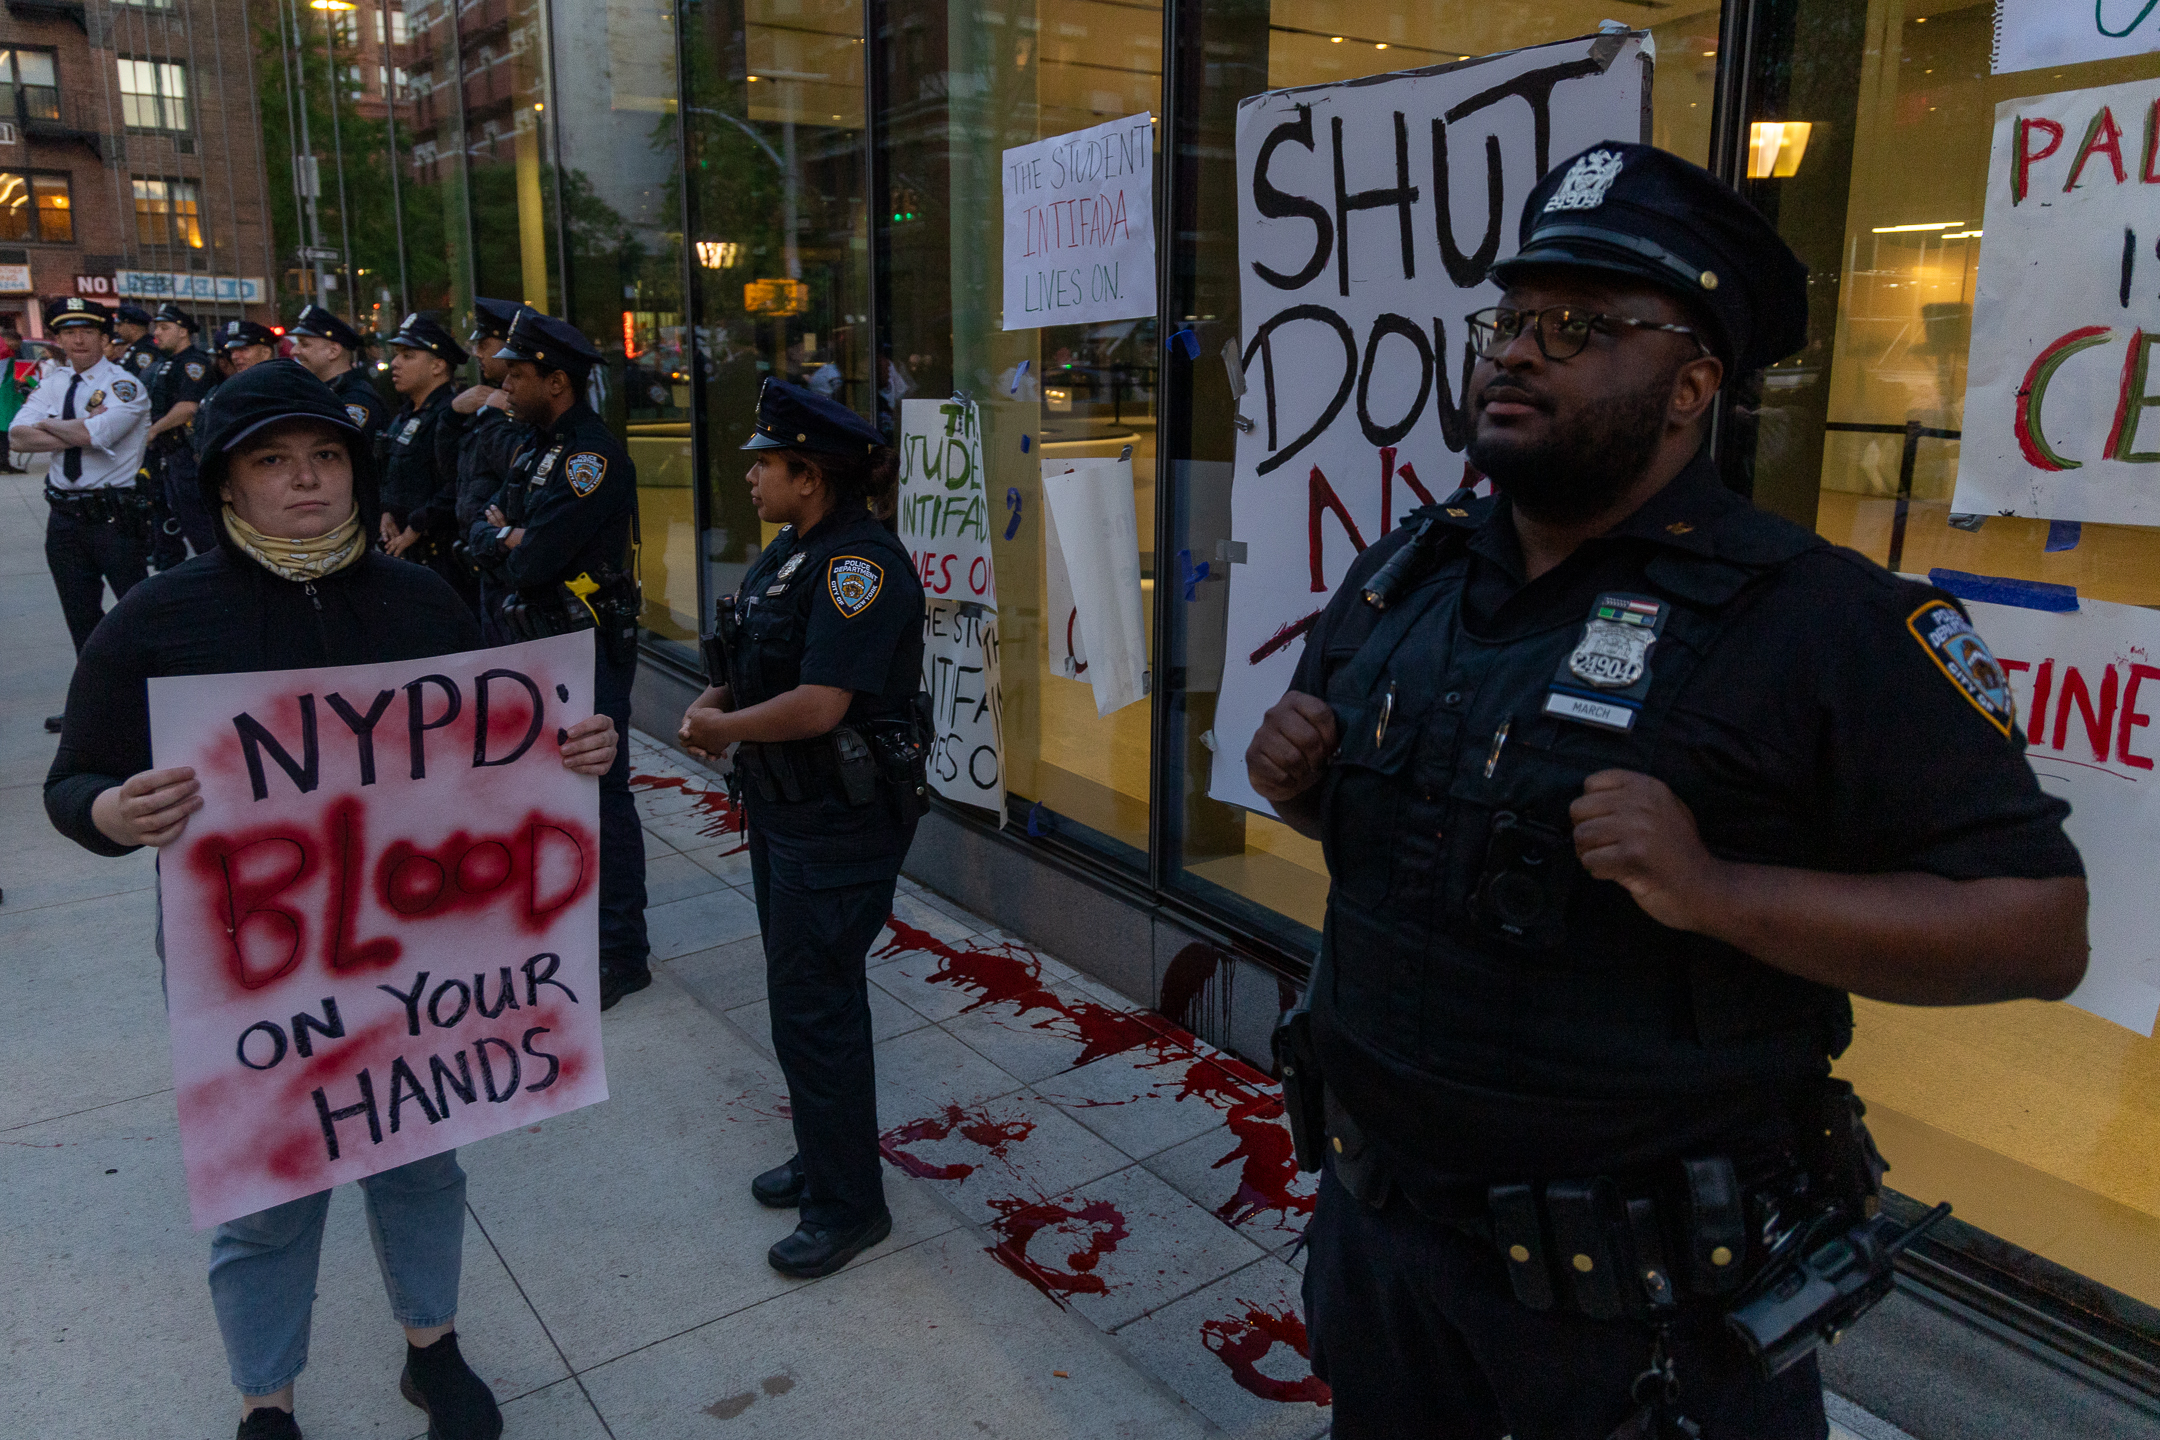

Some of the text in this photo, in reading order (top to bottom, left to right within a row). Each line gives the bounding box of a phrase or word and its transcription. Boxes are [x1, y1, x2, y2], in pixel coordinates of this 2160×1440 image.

[1011, 124, 1150, 194] THE STUDENT
[1252, 58, 1602, 297] SHUT
[2010, 96, 2160, 206] PAL
[1023, 189, 1129, 257] INTIFADA
[77, 275, 108, 293] NO
[1025, 261, 1124, 312] LIVES ON.
[939, 404, 979, 440] TH
[2014, 325, 2160, 472] CE
[901, 432, 982, 491] STUDE
[903, 492, 989, 544] INTIFAD
[1309, 447, 1494, 593] NY
[831, 580, 844, 605] CITY OF
[833, 565, 878, 581] DEPARTMENT
[844, 560, 870, 570] POLICE
[853, 585, 878, 611] NEW YORK
[1575, 654, 1637, 680] 24904
[233, 667, 570, 802] NYPD:
[1571, 702, 1611, 720] MARCH
[237, 953, 579, 1071] ON YOUR
[312, 1026, 560, 1161] HANDS
